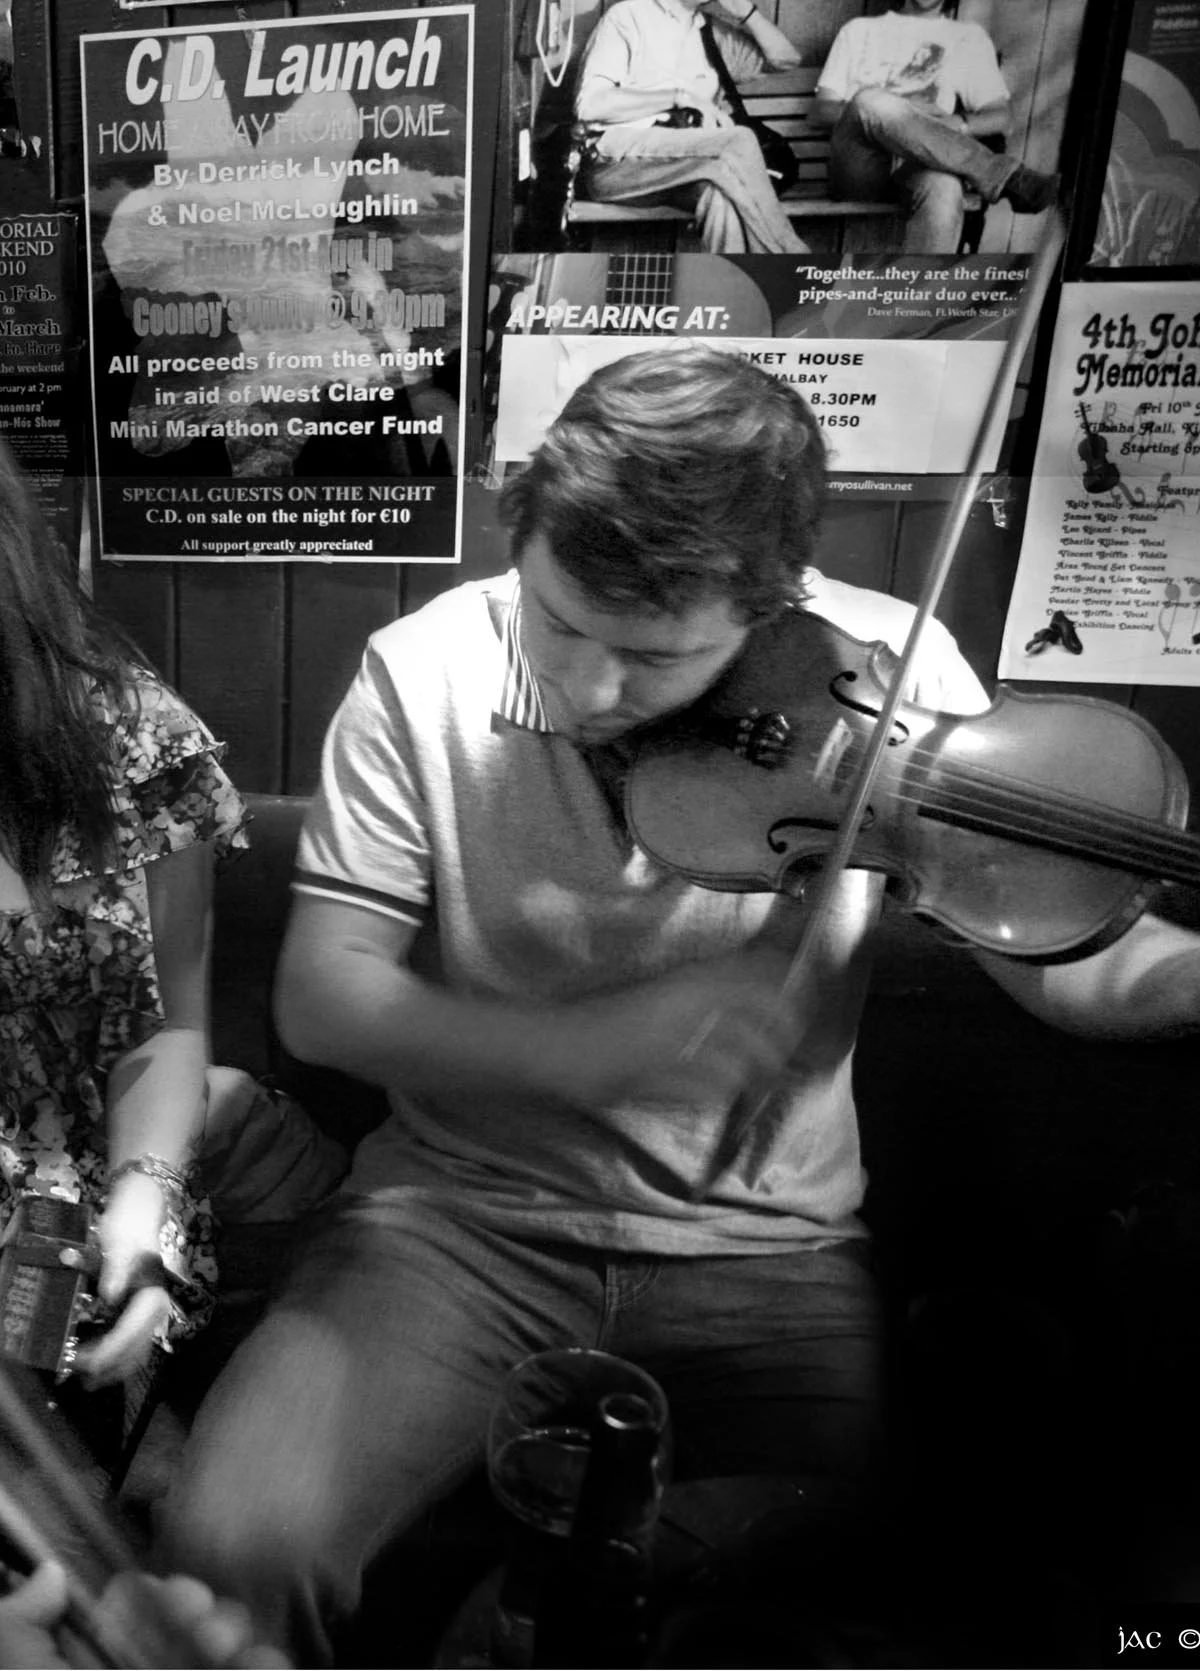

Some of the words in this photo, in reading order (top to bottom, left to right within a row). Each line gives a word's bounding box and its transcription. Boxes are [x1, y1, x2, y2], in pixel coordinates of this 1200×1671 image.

[126, 35, 226, 106] C.D.
[244, 19, 442, 97] Launch
[99, 120, 183, 154] HOME
[274, 111, 353, 144] FROM
[358, 104, 450, 140] HOME
[154, 164, 188, 190] By
[200, 158, 302, 184] Derrick
[314, 152, 400, 183] Lynch
[148, 205, 168, 226] &
[178, 201, 241, 225] Noel
[252, 194, 418, 224] McLoughlin
[182, 238, 256, 277] Friday
[262, 235, 312, 274] 21st
[924, 270, 950, 280] are
[954, 266, 980, 280] the
[984, 266, 1030, 281] finest
[11, 284, 56, 302] Feb.
[798, 287, 931, 304] pipes-and-guitar
[935, 287, 966, 301] duo
[132, 296, 244, 338] Cooney's
[322, 290, 346, 329] @
[350, 288, 446, 332] 9.30pm
[505, 304, 680, 330] APPEARING
[683, 306, 731, 330] AT:
[868, 307, 892, 316] Dave
[894, 307, 932, 318] Ferman,
[948, 307, 976, 316] Worth
[1082, 313, 1136, 349] 4th
[17, 362, 64, 373] weekend
[108, 355, 139, 374] All
[147, 352, 258, 377] proceeds
[266, 351, 322, 370] from
[332, 350, 372, 368] the
[379, 347, 445, 371] night
[798, 353, 864, 366] HOUSE
[28, 384, 36, 392] at
[39, 383, 44, 392] 2
[47, 384, 62, 394] pm
[154, 387, 176, 406] in
[184, 386, 220, 405] aid
[228, 386, 251, 404] of
[260, 384, 320, 404] West
[328, 383, 395, 402] Clare
[810, 392, 877, 406] 8.30PM
[1138, 402, 1162, 414] Fri
[34, 416, 61, 428] Show
[110, 420, 158, 438] Mini
[165, 418, 278, 438] Marathon
[286, 416, 375, 436] Cancer
[382, 416, 443, 434] Fund
[818, 415, 860, 427] 1650
[1120, 442, 1180, 456] Starting
[122, 487, 203, 502] SPECIAL
[207, 486, 284, 502] GUESTS
[288, 486, 317, 502] ON
[322, 486, 362, 501] THE
[368, 486, 436, 502] NIGHT
[146, 509, 182, 524] C.D.
[187, 512, 206, 524] on
[211, 510, 242, 524] sale
[246, 512, 266, 524] on
[272, 509, 298, 524] the
[302, 508, 346, 527] night
[350, 508, 376, 524] for
[380, 508, 410, 524] €10
[181, 540, 199, 550] All
[202, 540, 250, 554] support
[252, 540, 296, 553] greatly
[300, 540, 373, 552] appreciated
